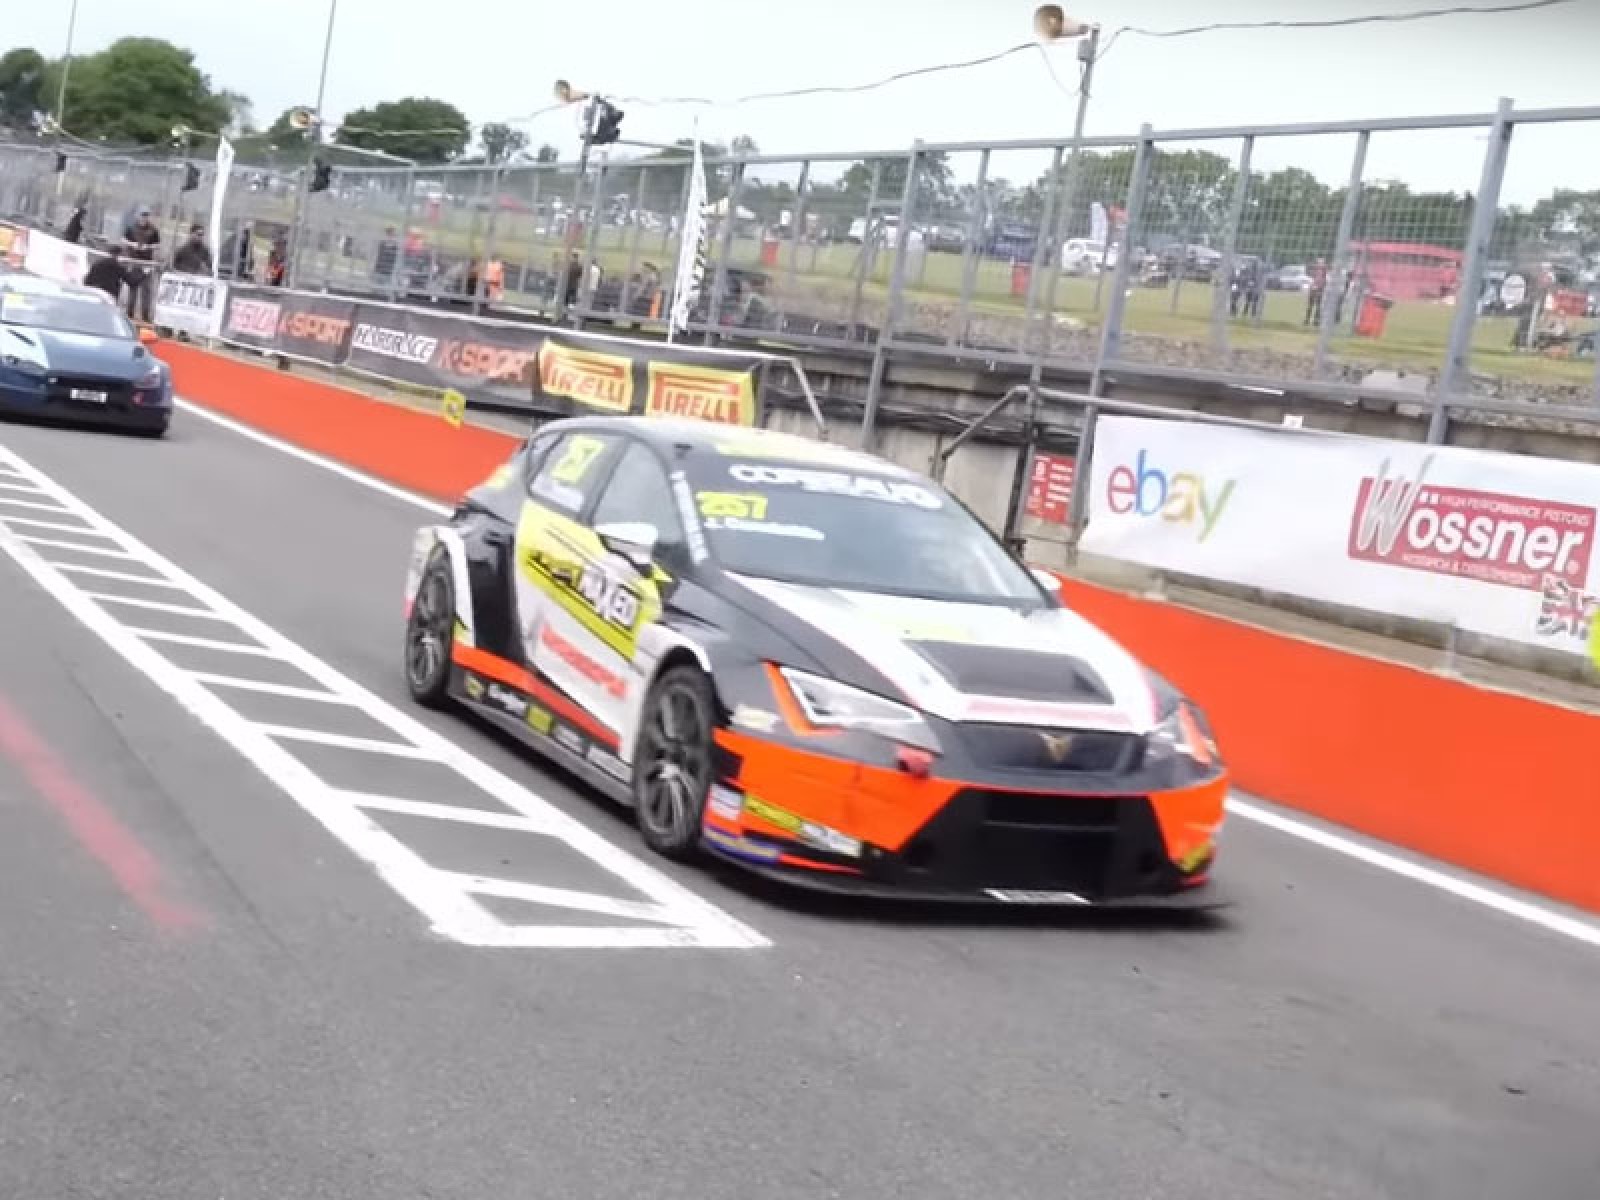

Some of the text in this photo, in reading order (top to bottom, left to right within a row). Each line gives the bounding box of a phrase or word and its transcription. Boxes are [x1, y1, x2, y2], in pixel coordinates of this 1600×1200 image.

[541, 351, 627, 403] PIRELLI
[652, 371, 740, 425] PIRELLI
[1107, 448, 1236, 543] ebay
[1357, 452, 1584, 573] Wössner
